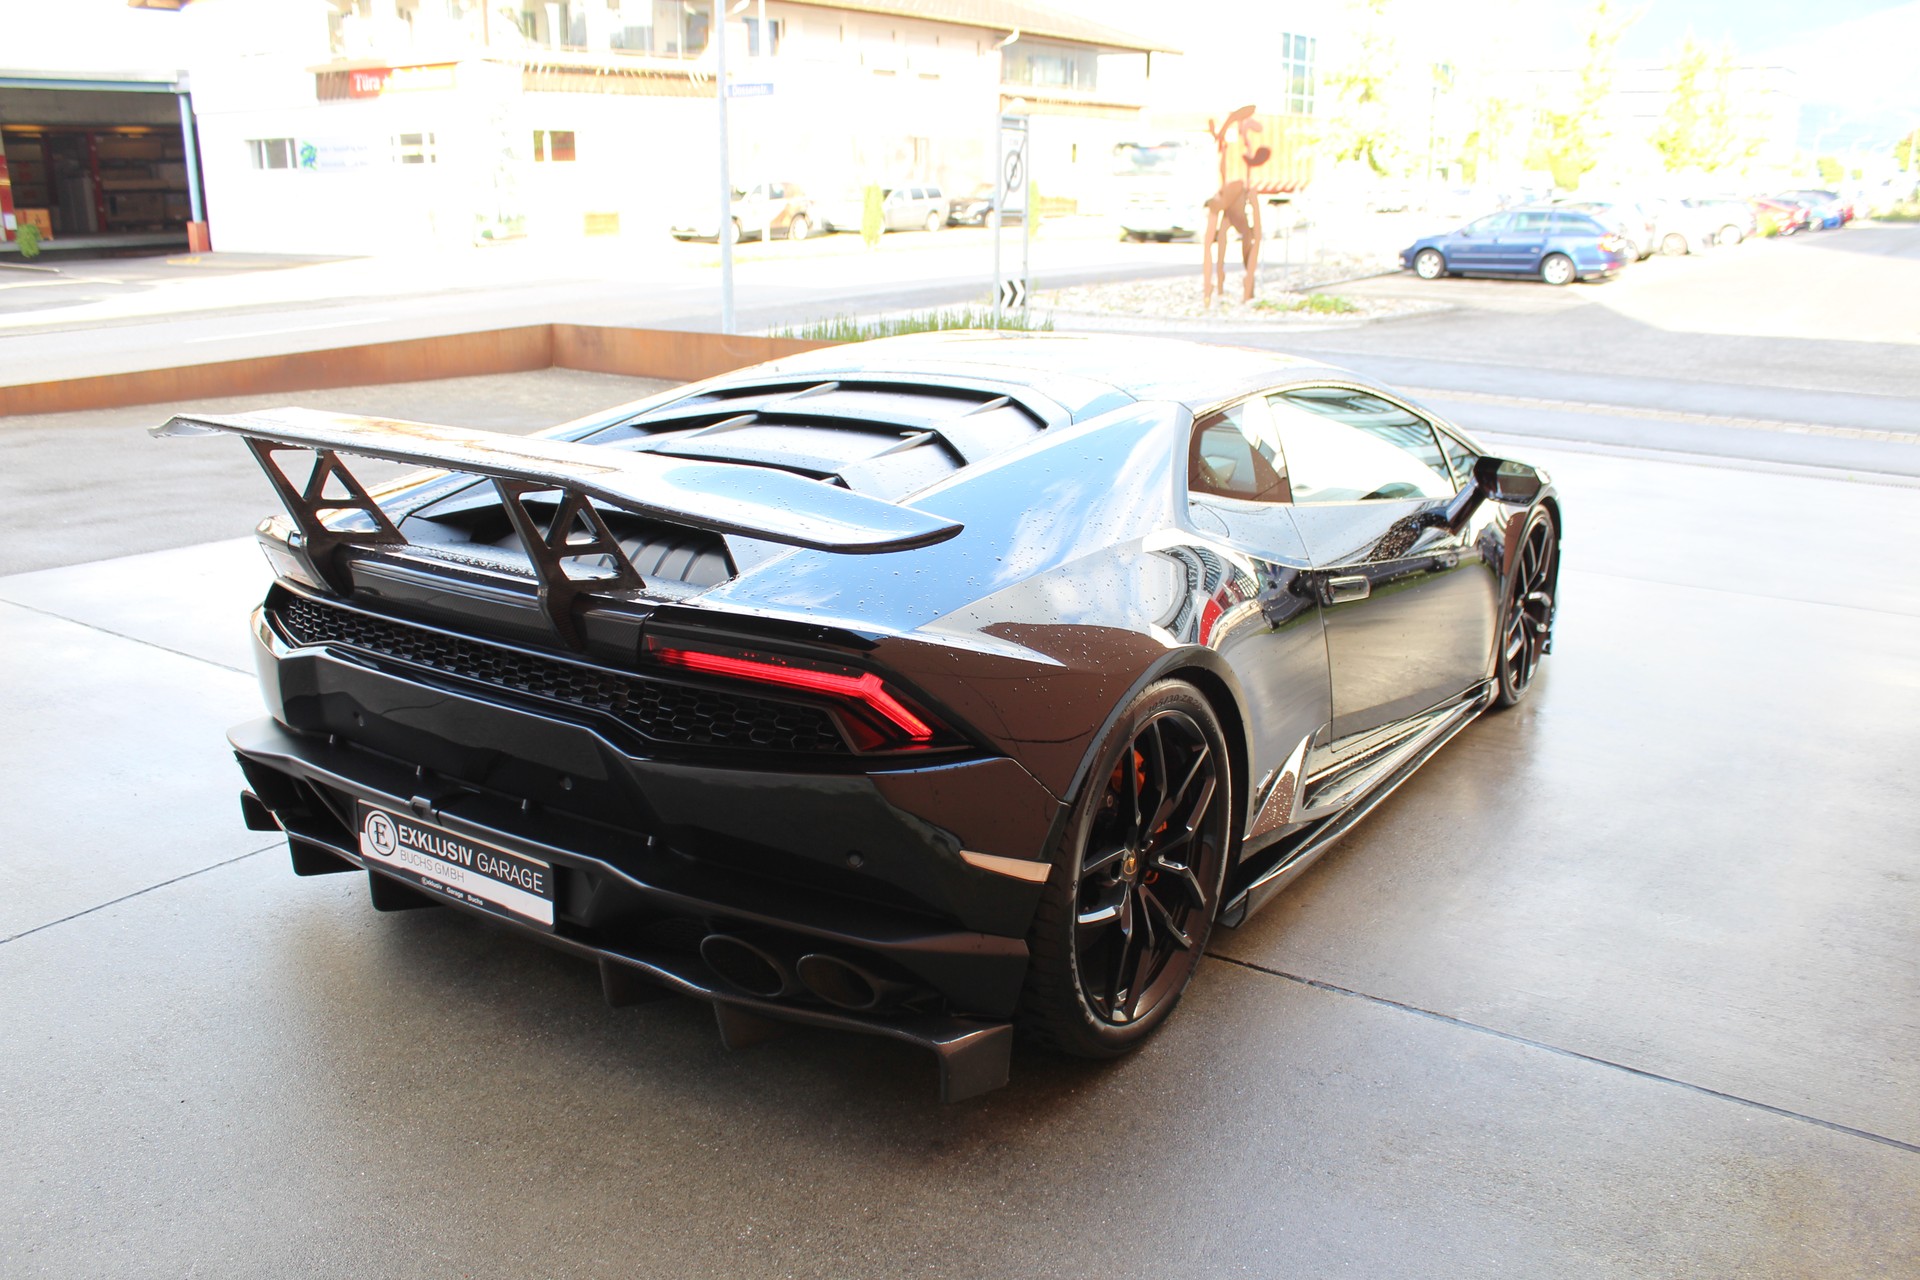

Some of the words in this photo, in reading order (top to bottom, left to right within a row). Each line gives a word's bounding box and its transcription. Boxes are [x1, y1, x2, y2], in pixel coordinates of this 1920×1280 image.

[398, 824, 473, 866] EXKLUSIV
[476, 852, 544, 894] GARAGE
[400, 849, 434, 872] BUCHS
[434, 861, 465, 883] GMBH
[467, 894, 484, 906] Buchs
